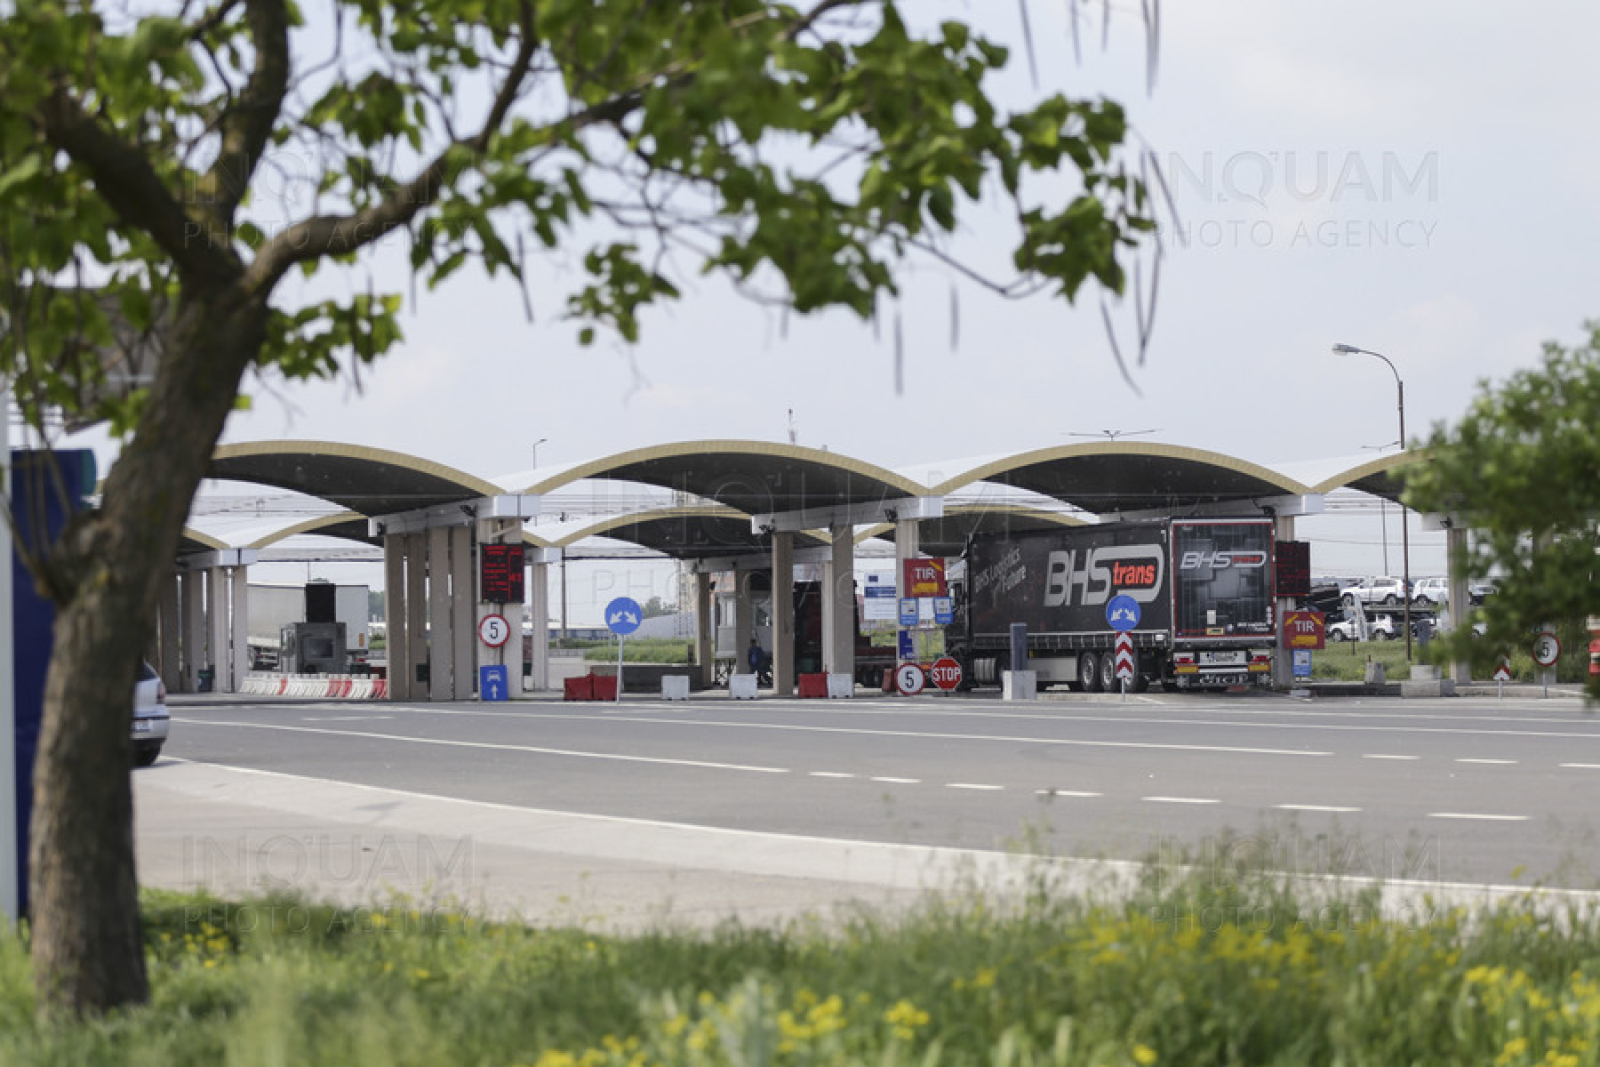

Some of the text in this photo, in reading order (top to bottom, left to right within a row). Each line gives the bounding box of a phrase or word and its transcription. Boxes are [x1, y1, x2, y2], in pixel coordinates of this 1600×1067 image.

[1180, 551, 1231, 570] BHS
[914, 567, 935, 580] TIR
[1112, 561, 1155, 586] trans
[489, 621, 499, 640] 5
[1293, 619, 1315, 633] TIR
[904, 670, 915, 689] 5
[932, 667, 962, 682] STOP
